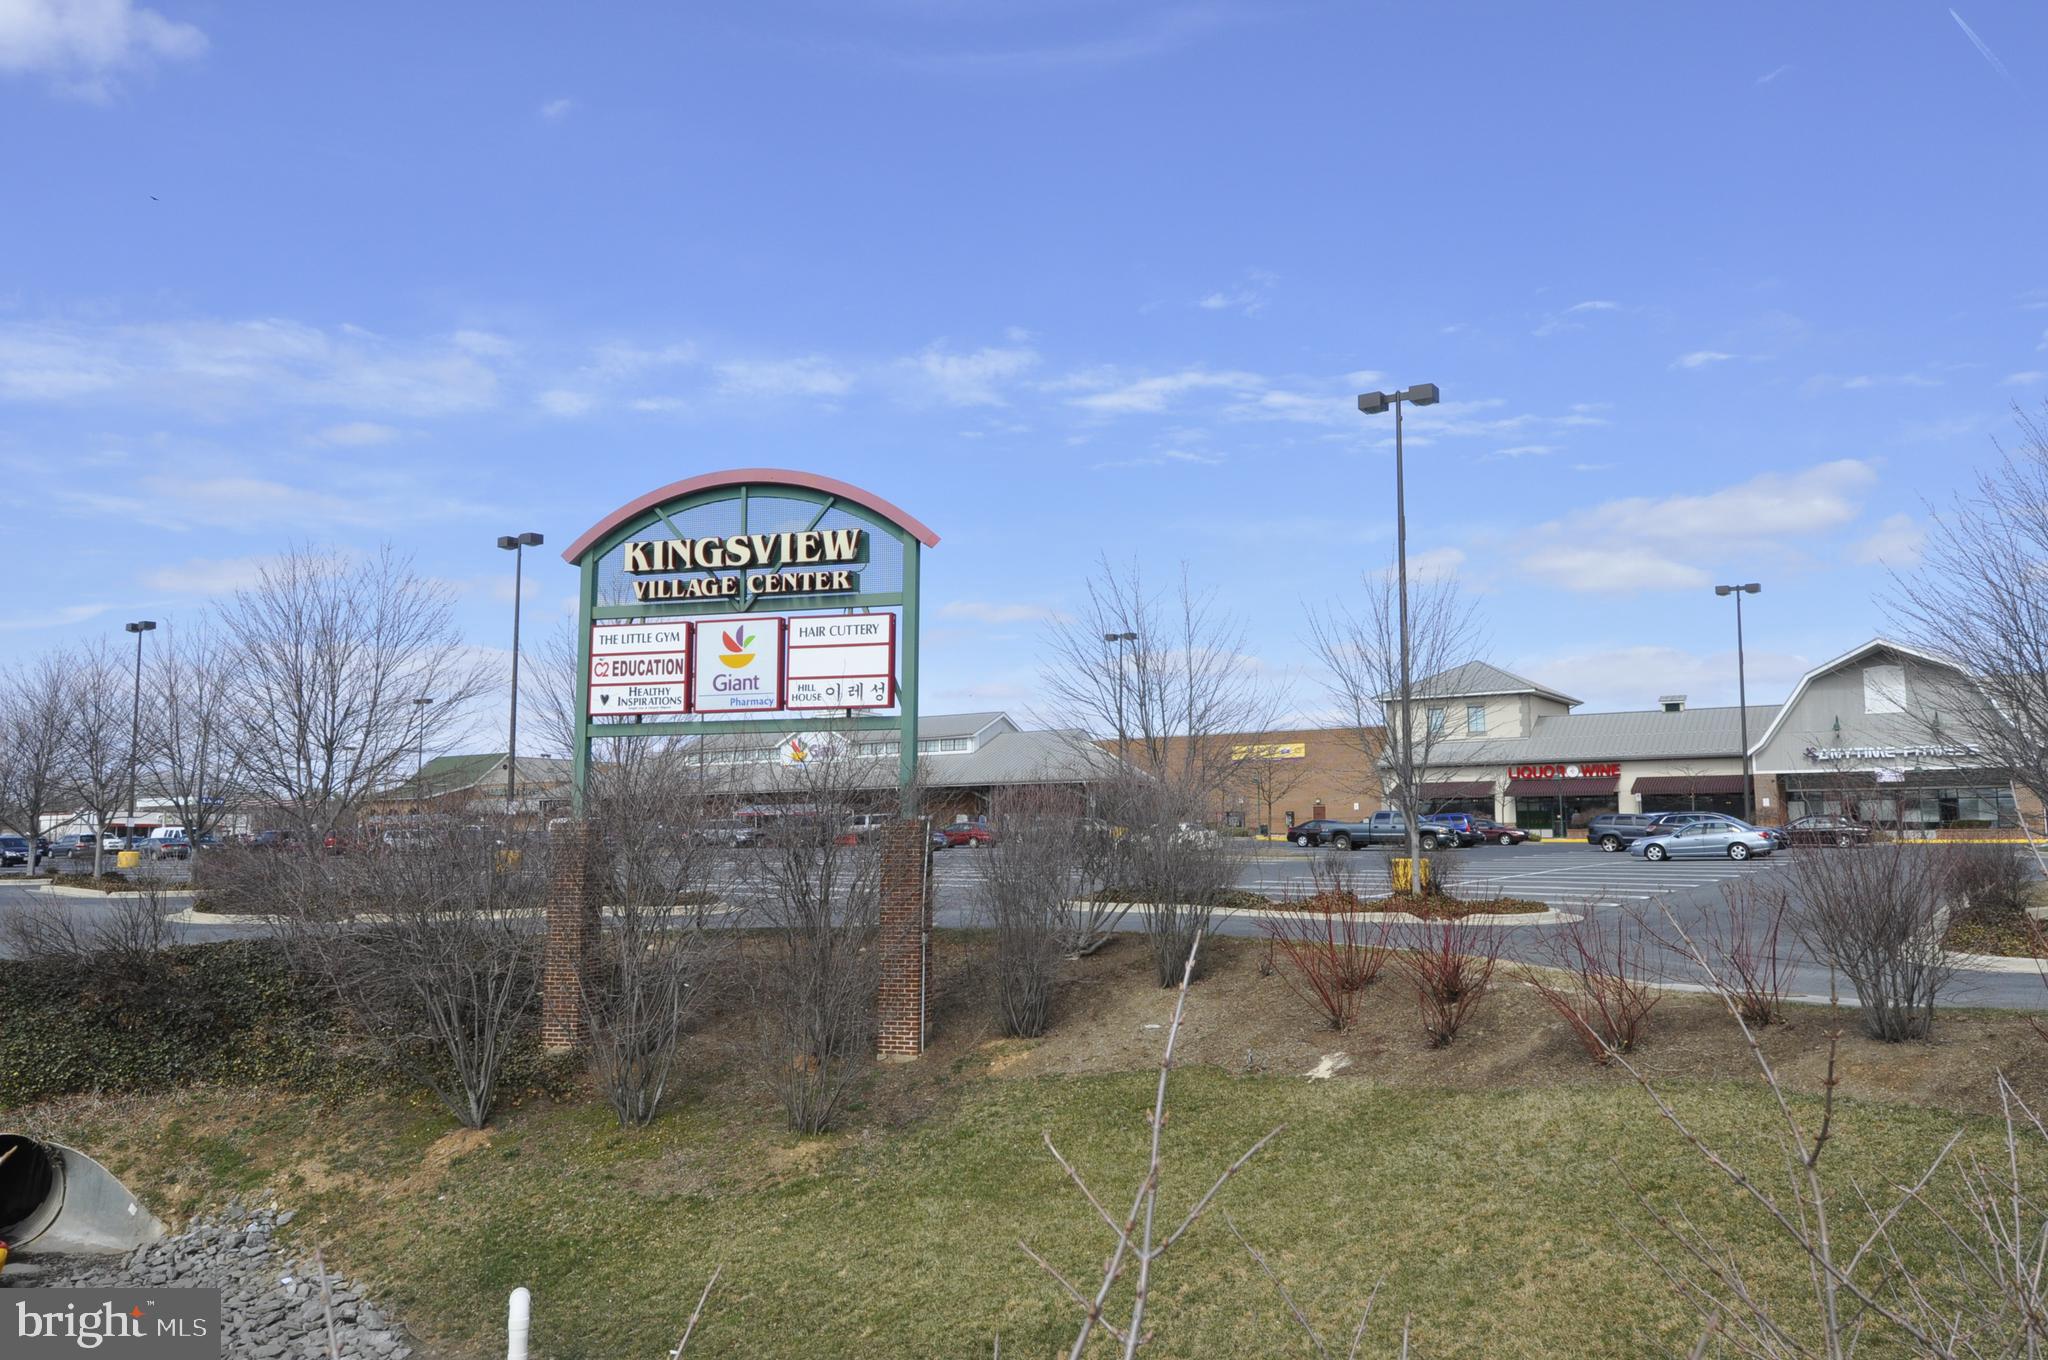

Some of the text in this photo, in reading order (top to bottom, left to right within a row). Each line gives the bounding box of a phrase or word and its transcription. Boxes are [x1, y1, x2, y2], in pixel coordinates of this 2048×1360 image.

[623, 528, 863, 573] KINGSVIEW
[631, 570, 853, 601] VILLAGE CENTER
[799, 624, 879, 637] HAIR CUTTERY
[599, 632, 680, 645] THE LITTLE GYM
[612, 658, 684, 677] EDUCATION
[712, 673, 760, 692] Giant
[797, 684, 816, 692] HILL
[628, 686, 672, 697] HEALTHY
[791, 693, 822, 702] HOUSE
[617, 696, 682, 707] INSPIRATIONS
[730, 697, 775, 707] Pharmacy
[1817, 746, 1896, 760] ANYTIME
[1579, 763, 1621, 778] WINE
